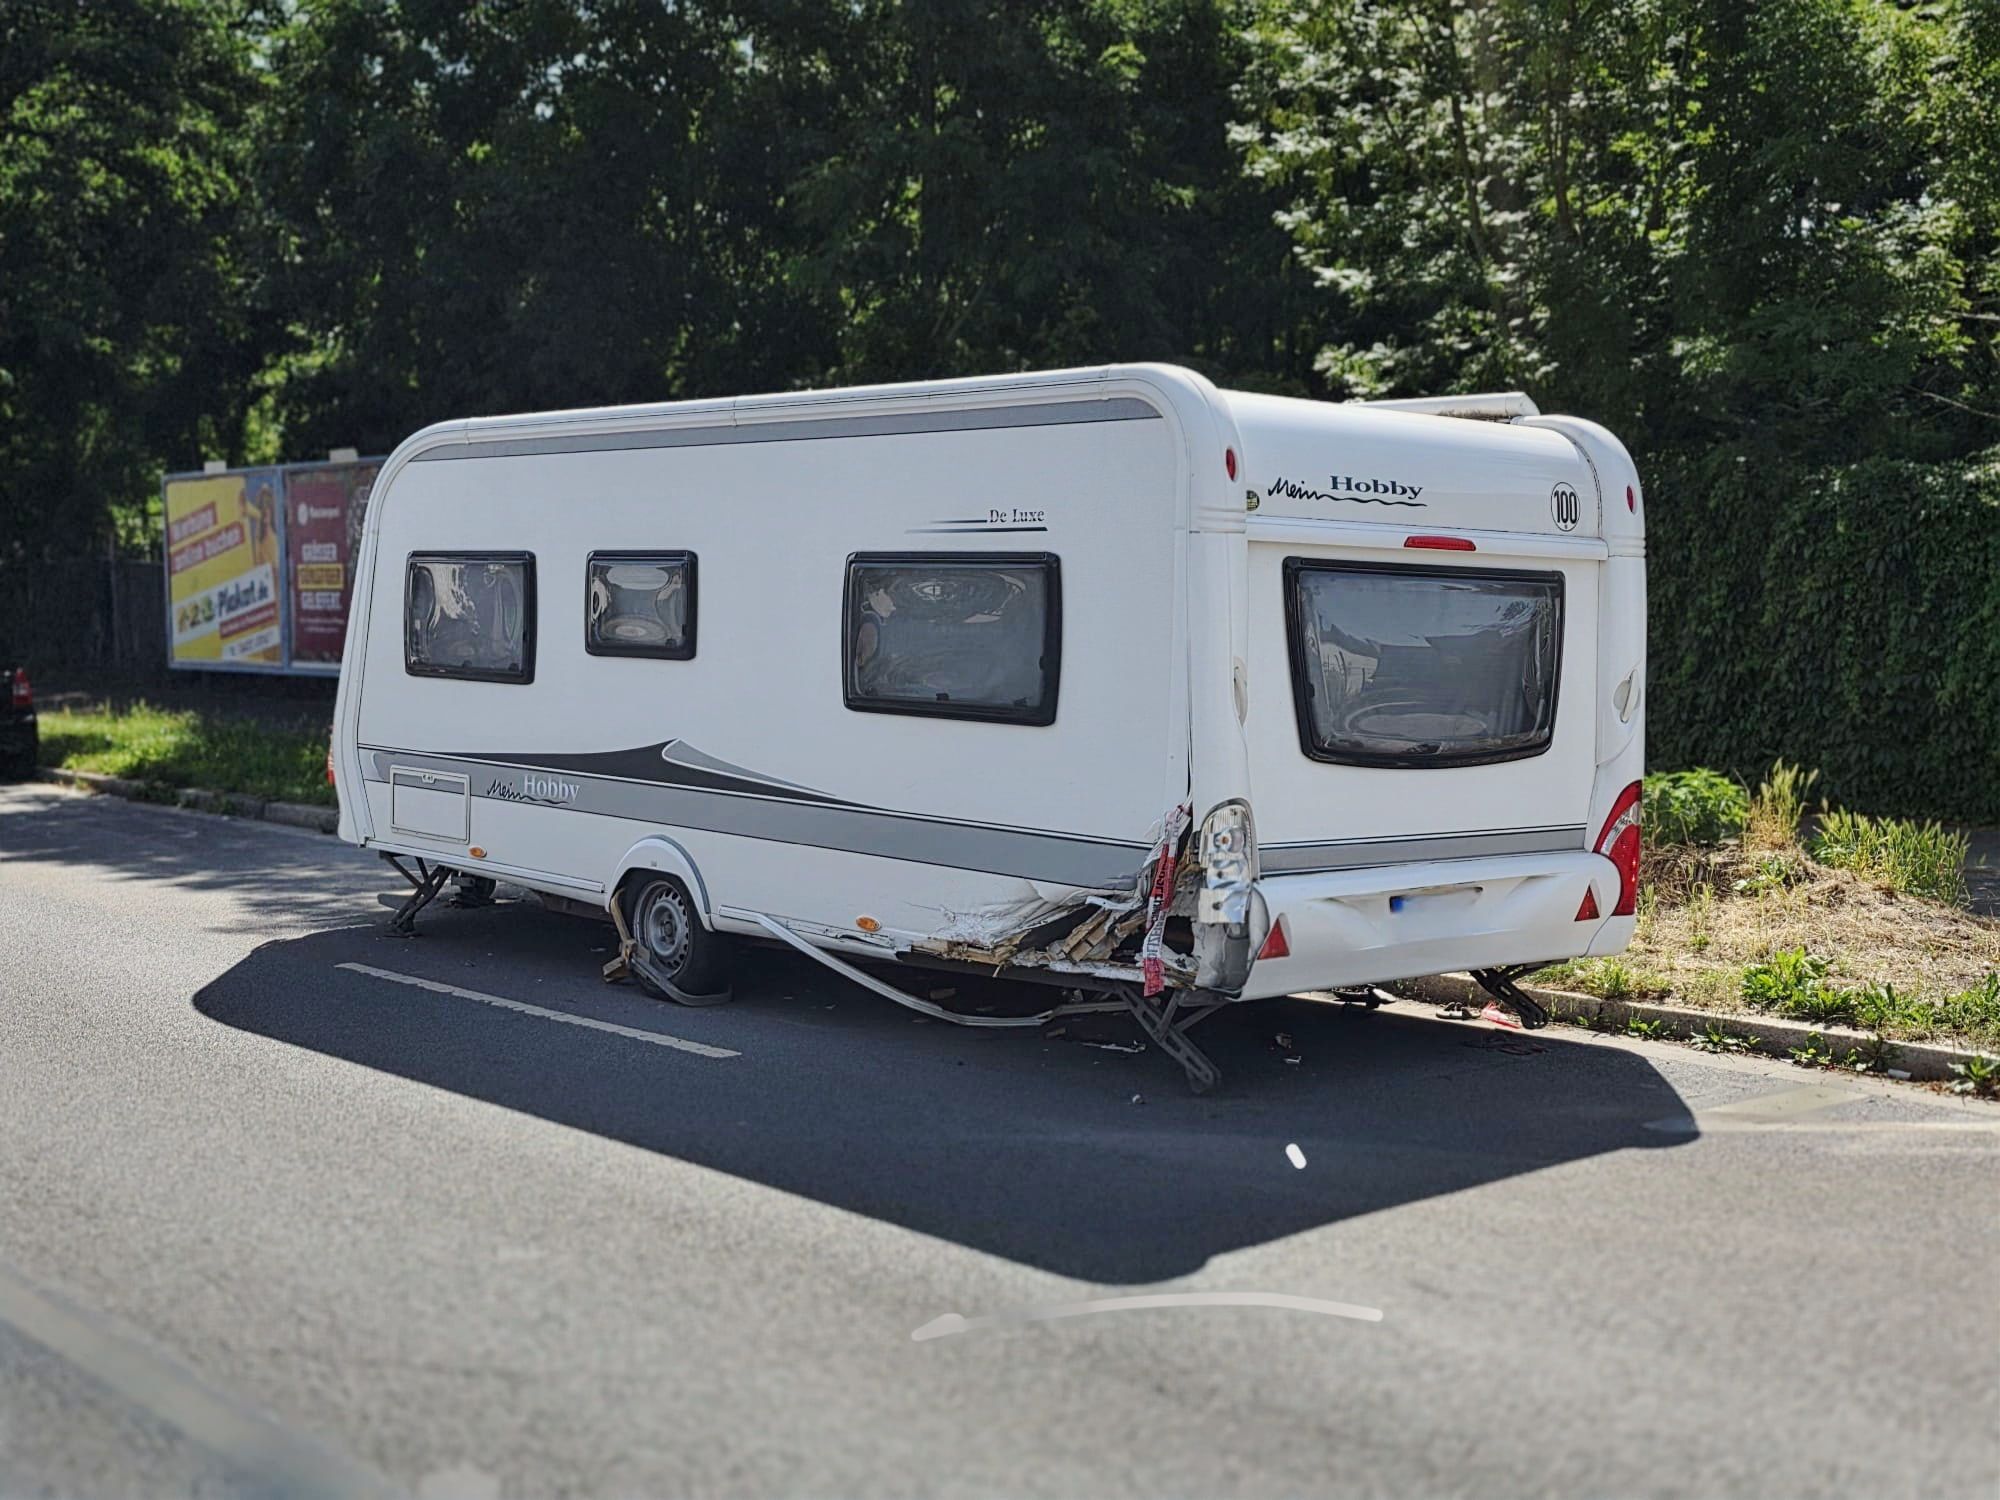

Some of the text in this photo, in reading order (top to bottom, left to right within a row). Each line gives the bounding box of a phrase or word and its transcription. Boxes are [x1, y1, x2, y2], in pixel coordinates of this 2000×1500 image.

[1268, 475, 1423, 500] Mein Hobby
[989, 508, 1045, 523] De Luxe
[1554, 490, 1577, 524] 100
[487, 774, 579, 801] Mein Hobby
